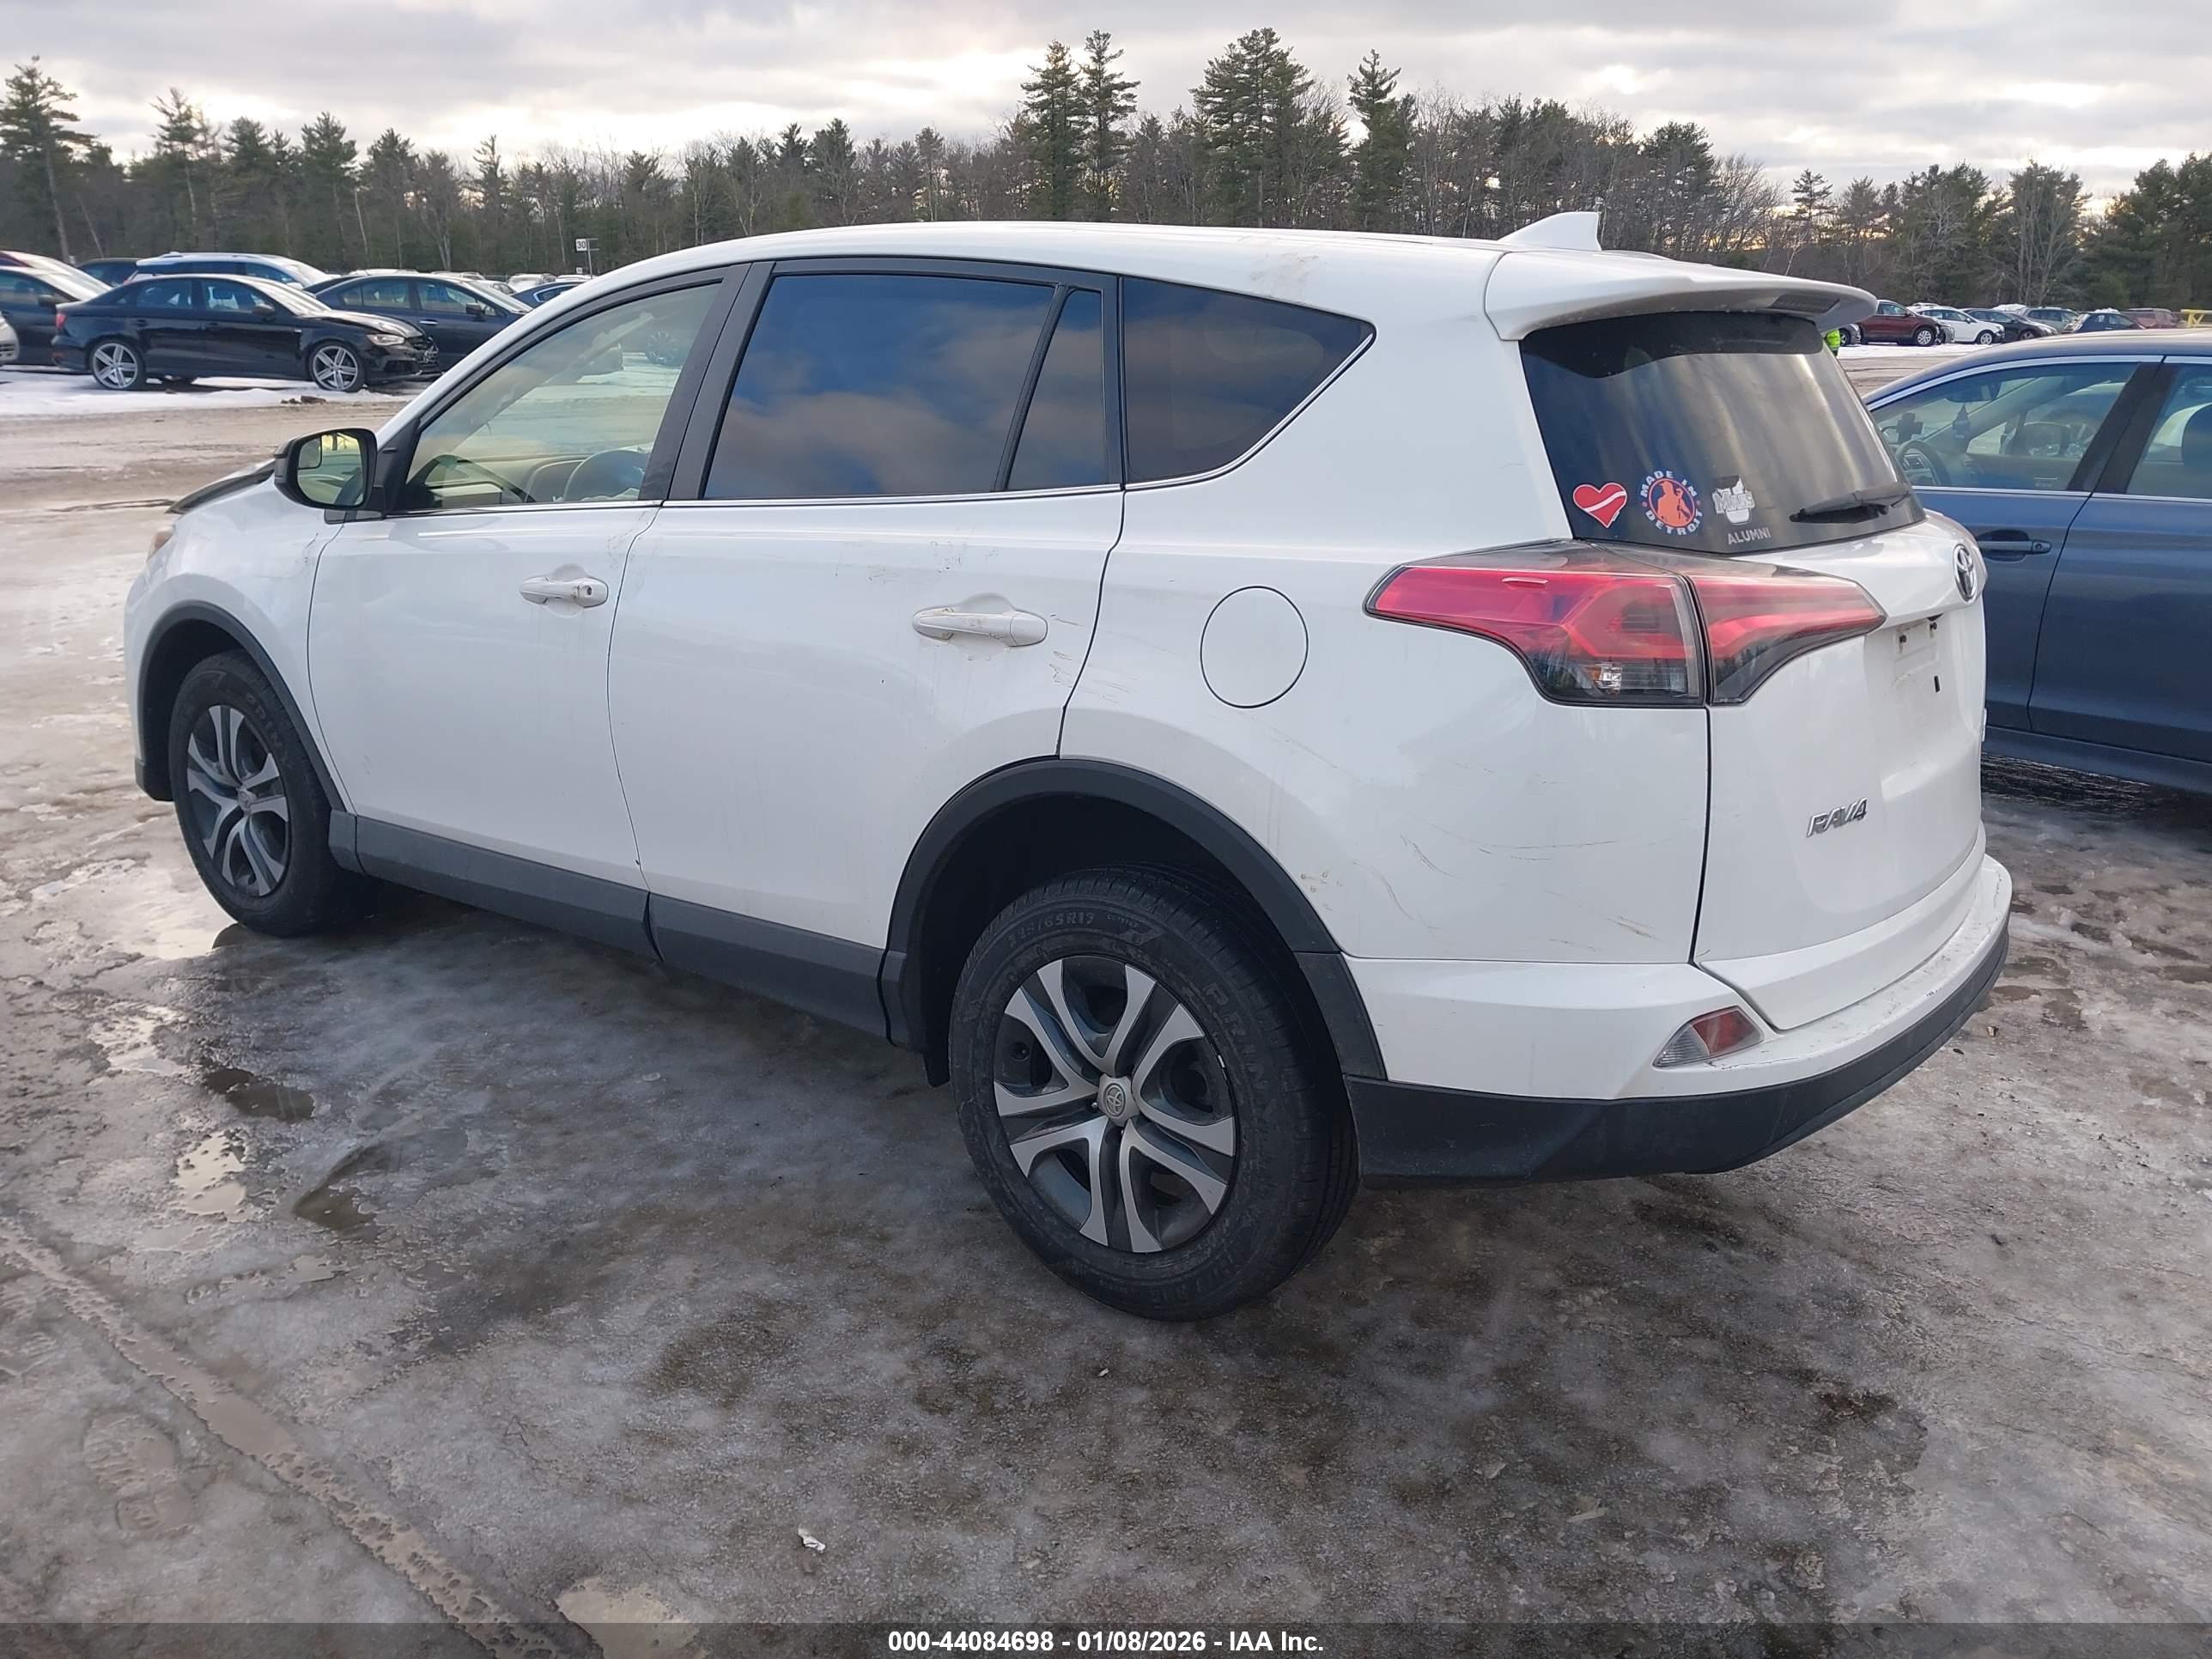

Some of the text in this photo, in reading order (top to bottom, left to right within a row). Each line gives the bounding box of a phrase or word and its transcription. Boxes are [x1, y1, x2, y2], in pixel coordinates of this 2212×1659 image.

[577, 240, 586, 249] 30
[1640, 471, 1698, 498] MADE IN
[1645, 507, 1703, 535] DETROIT
[1728, 527, 1771, 544] ALUMNI
[1807, 798, 1868, 838] RAV4
